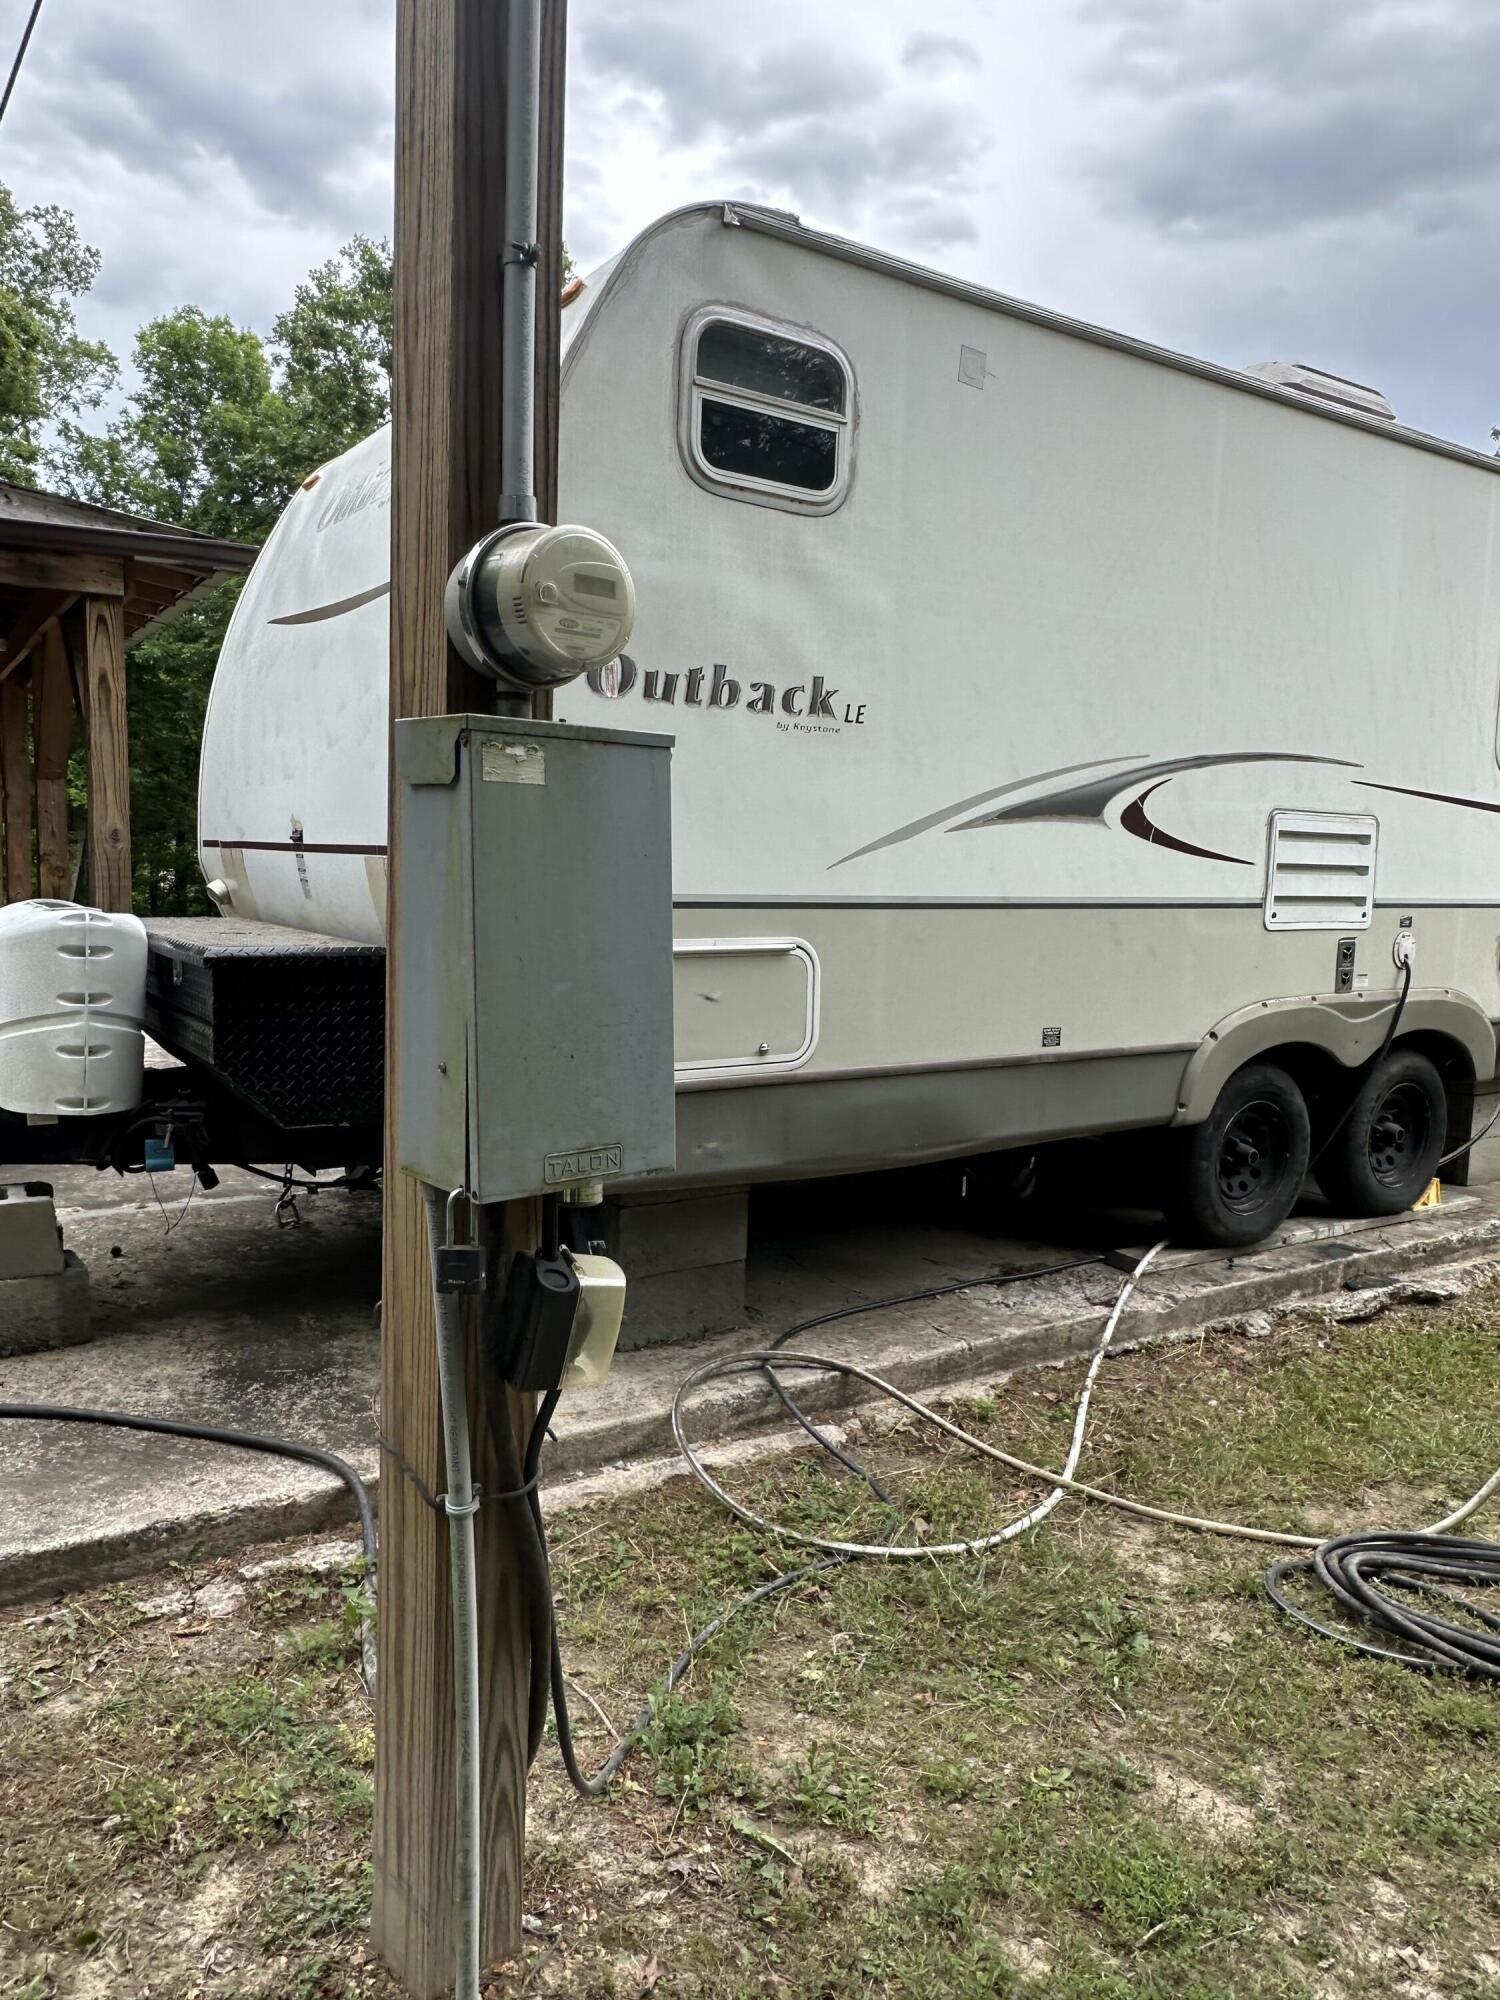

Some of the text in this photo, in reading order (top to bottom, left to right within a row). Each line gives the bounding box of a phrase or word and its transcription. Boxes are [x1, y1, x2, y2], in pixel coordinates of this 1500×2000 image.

[587, 654, 867, 724] Outback LE
[776, 721, 841, 734] by Keystone
[547, 1151, 619, 1177] TALON
